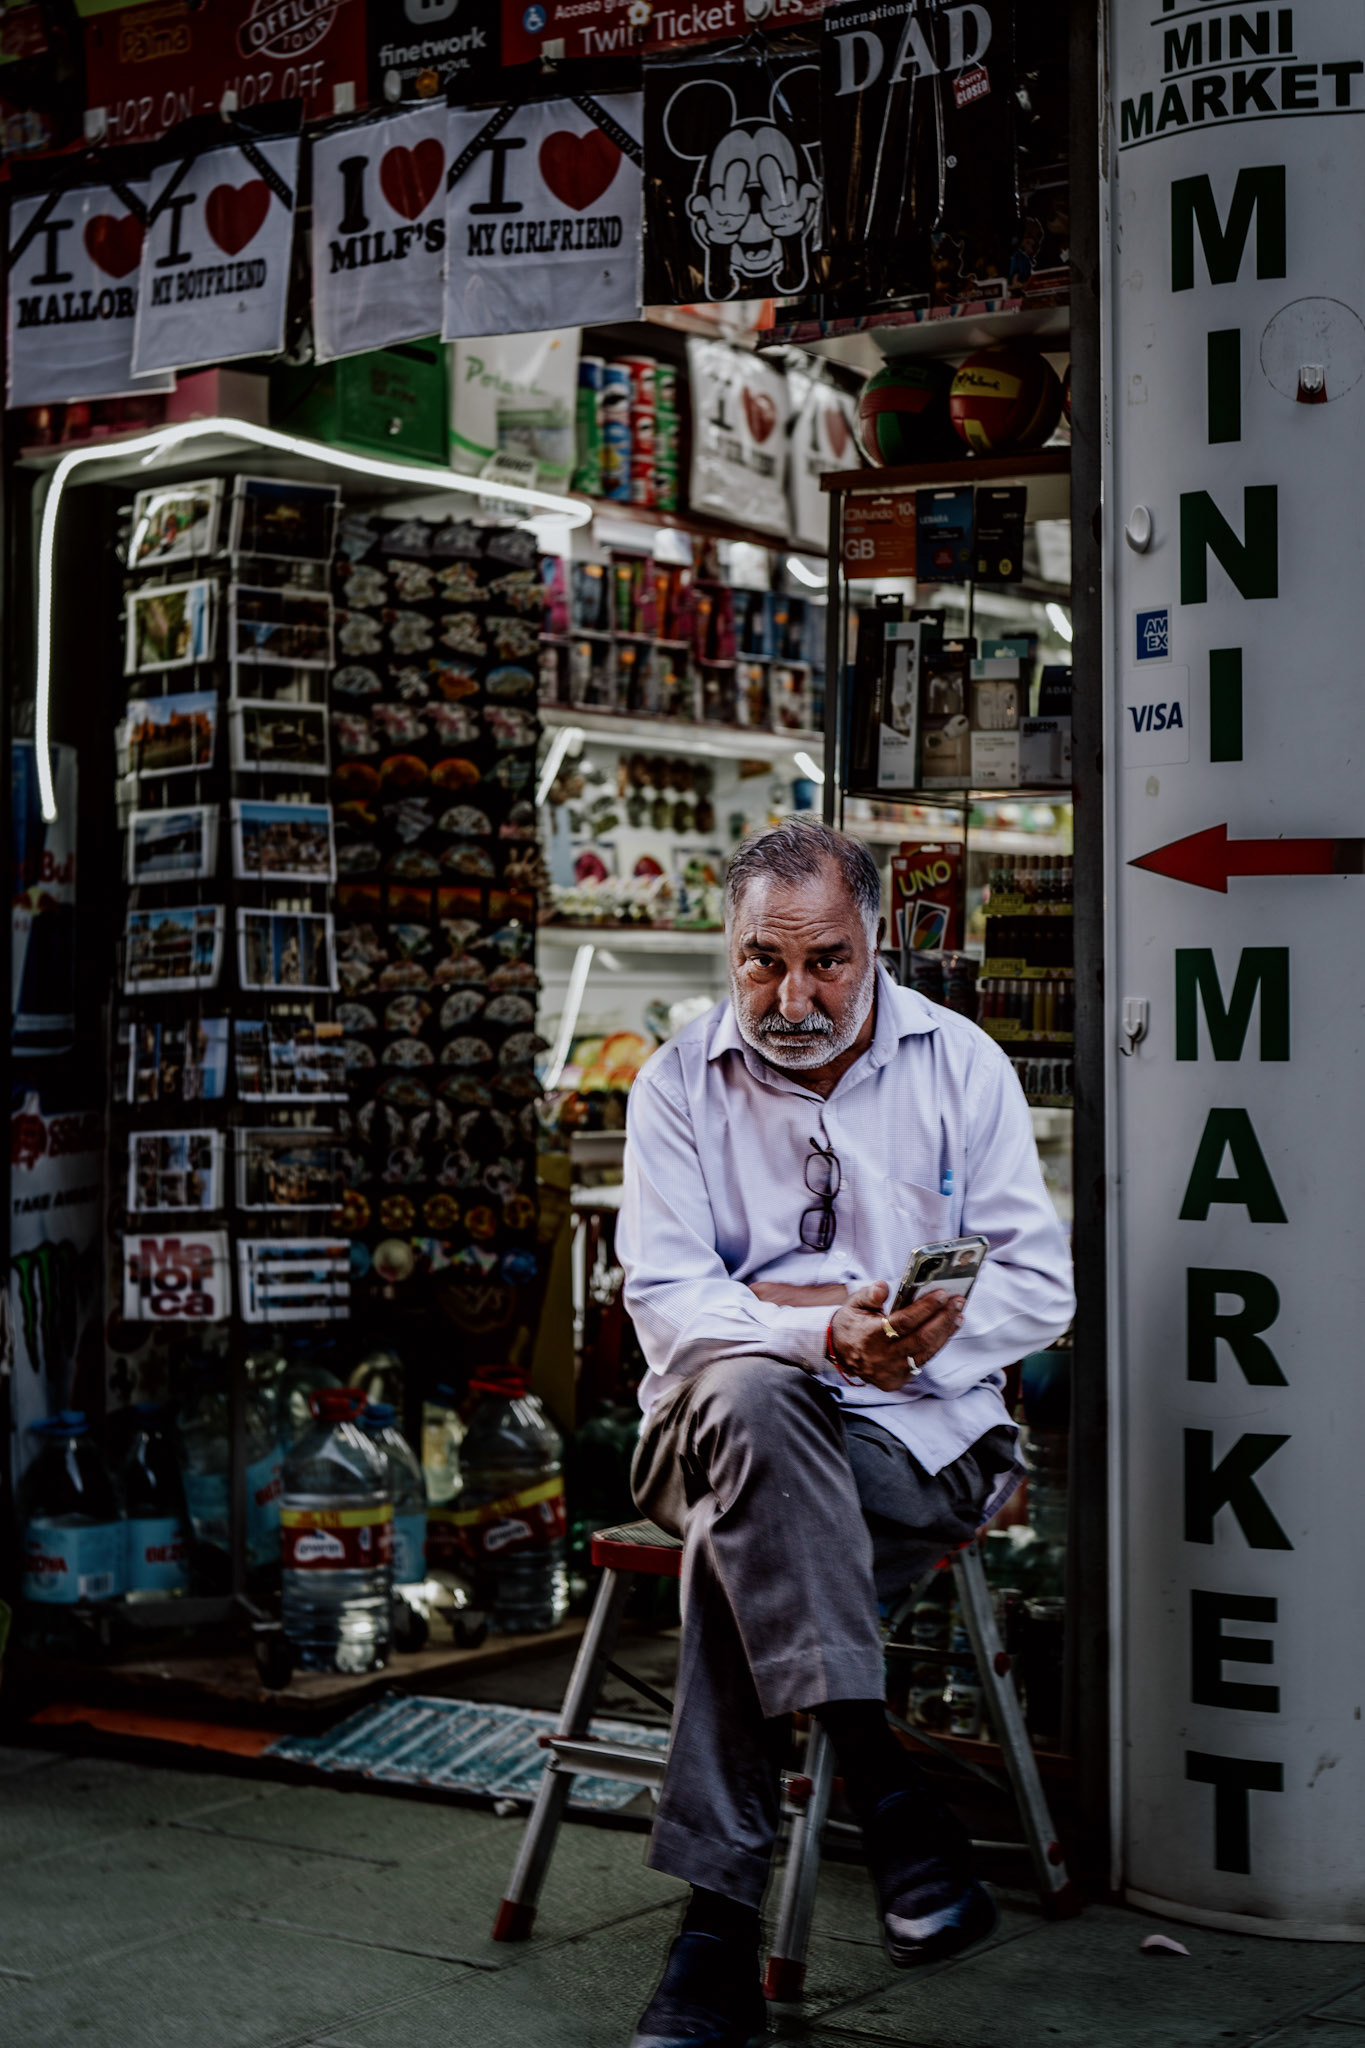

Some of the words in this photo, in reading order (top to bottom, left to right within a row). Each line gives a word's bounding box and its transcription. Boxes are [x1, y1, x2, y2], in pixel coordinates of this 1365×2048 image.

[652, 3, 737, 41] Ticket
[825, 0, 918, 31] International
[377, 25, 488, 68] finetwork
[833, 3, 993, 97] DAD
[1164, 10, 1293, 73] MINI
[106, 95, 154, 136] HOP
[161, 85, 195, 127] ON
[281, 60, 325, 100] OFF
[1121, 62, 1364, 142] MARKET
[338, 155, 369, 234] I
[469, 138, 526, 214] I
[155, 193, 196, 268] I
[467, 224, 496, 256] MY
[501, 216, 622, 255] GIRLFRIEND
[151, 274, 174, 307] MY
[175, 258, 267, 304] BOYFRIEND
[17, 286, 137, 328] MALLOR
[1171, 165, 1287, 762] MINI
[845, 538, 875, 560] GB
[1144, 619, 1168, 635] AM
[1147, 635, 1168, 650] EX
[1127, 702, 1183, 733] VISA
[40, 850, 73, 885] Bul
[897, 859, 952, 898] UNO
[1176, 946, 1294, 1875] MARKET
